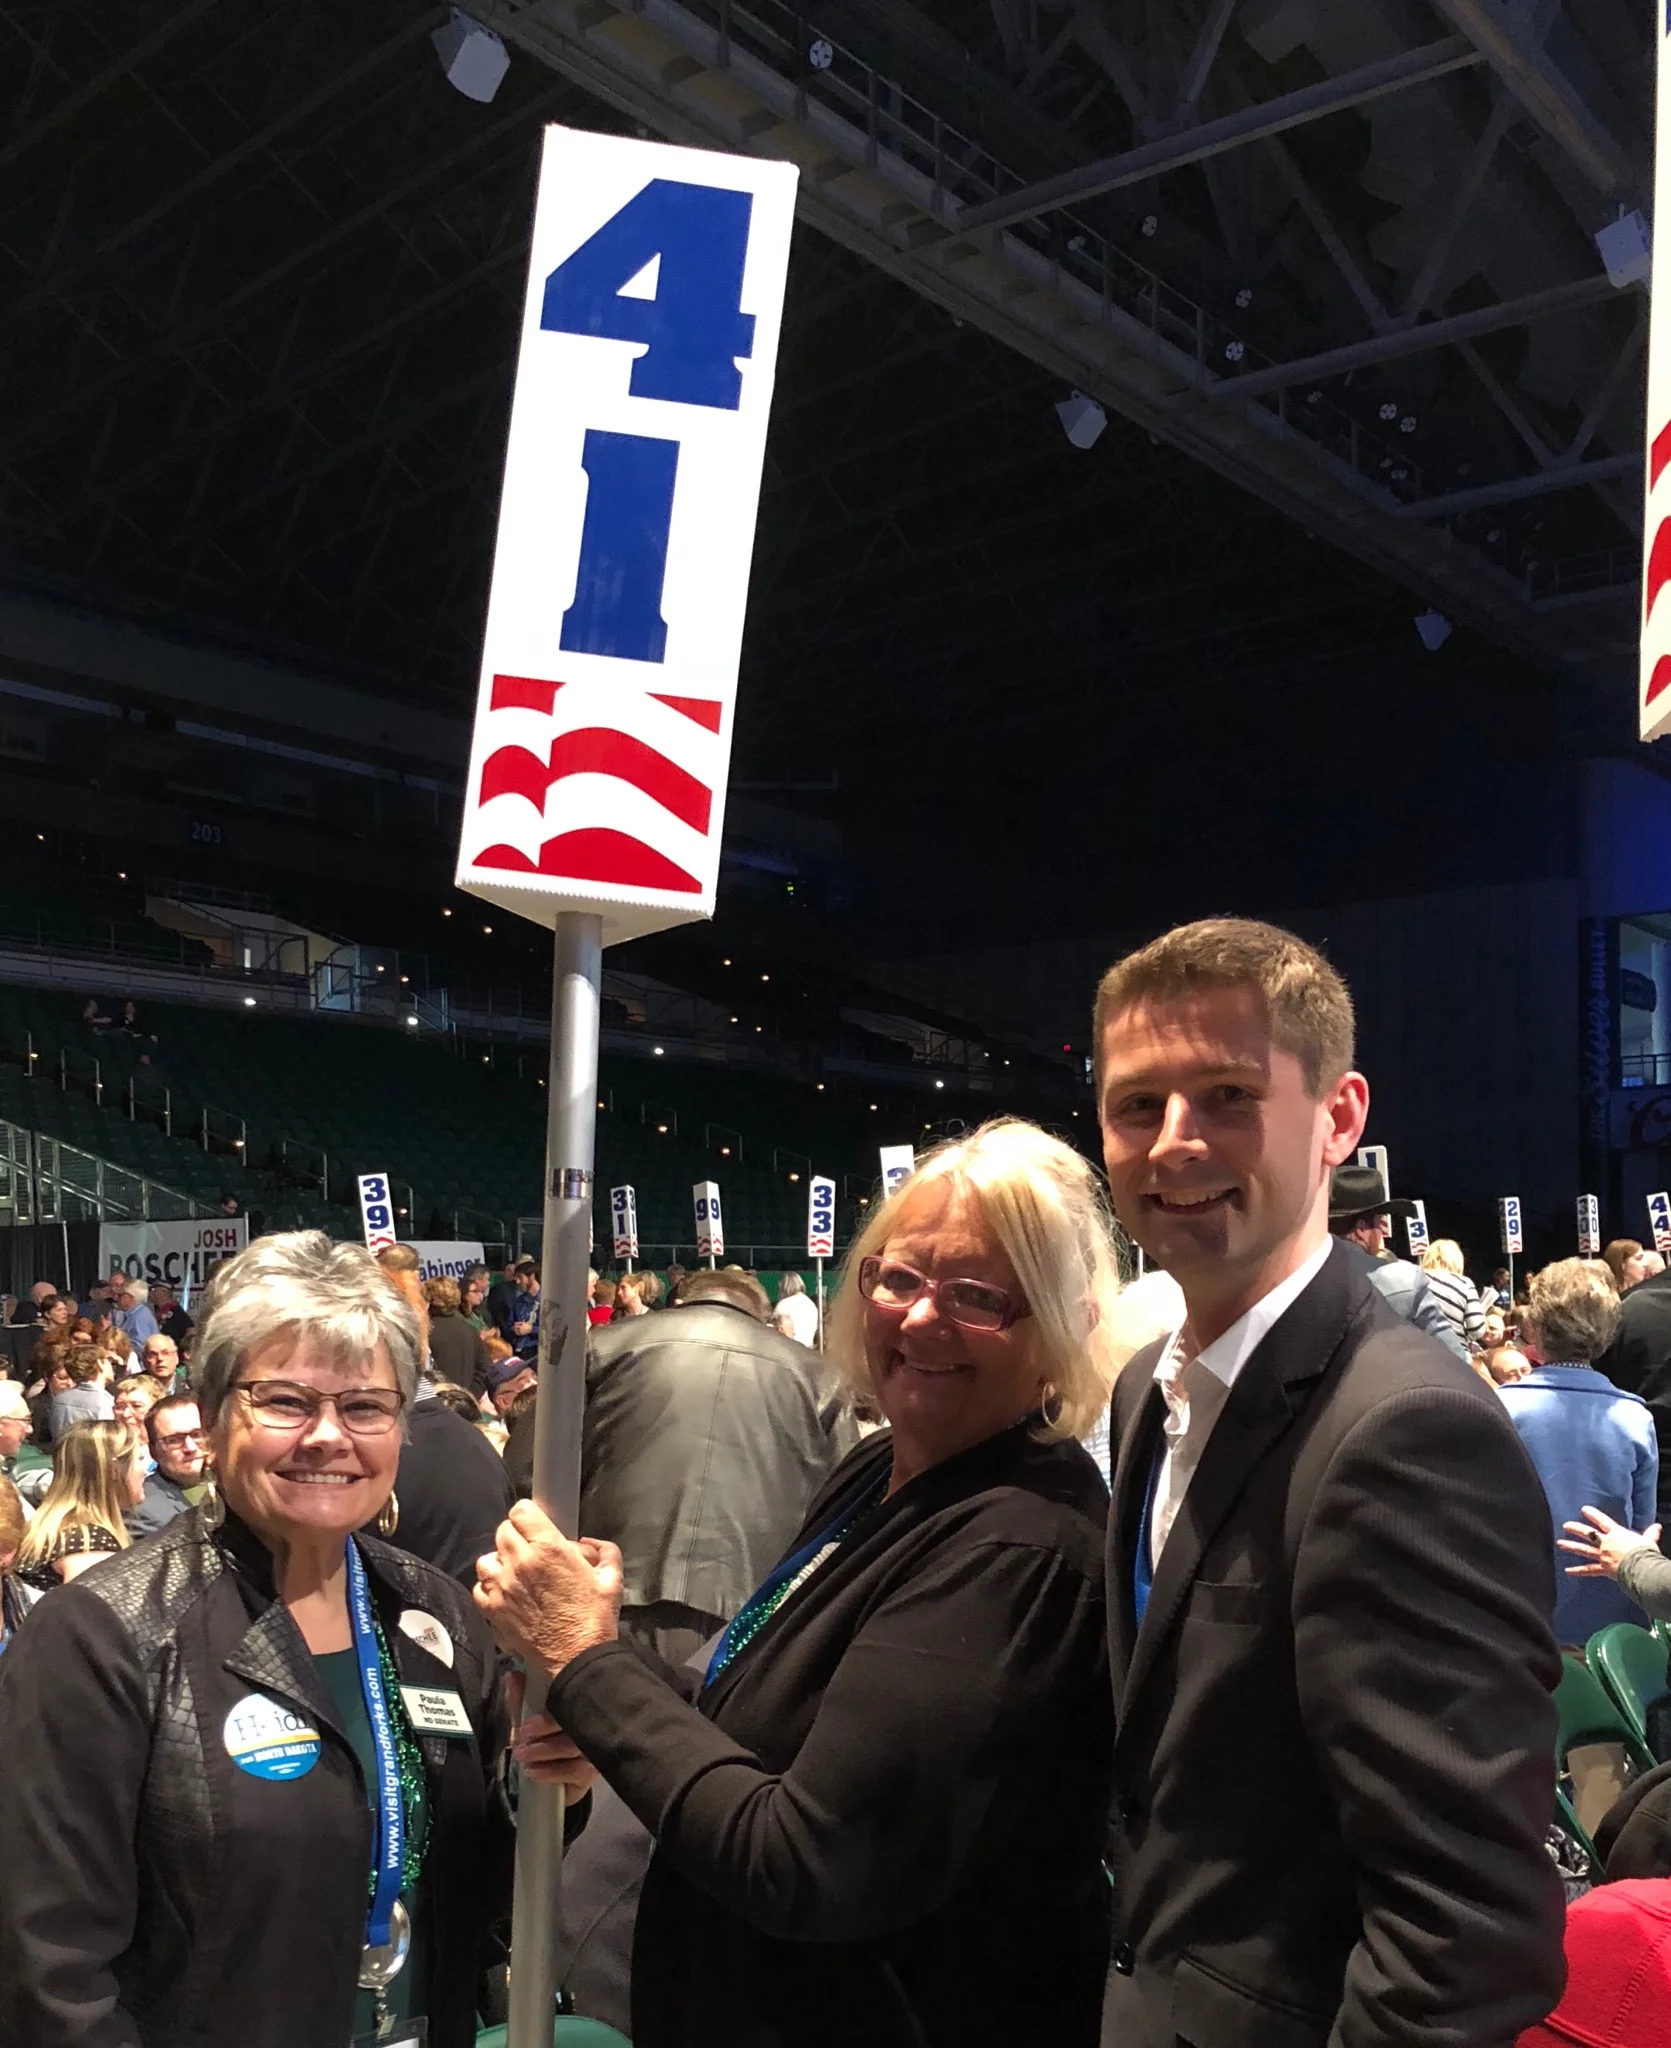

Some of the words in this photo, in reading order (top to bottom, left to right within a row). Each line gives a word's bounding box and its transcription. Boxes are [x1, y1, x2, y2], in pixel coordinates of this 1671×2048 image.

[191, 822, 221, 843] 203
[362, 1177, 390, 1230] 39
[612, 1189, 628, 1235] 31
[696, 1198, 708, 1221] 9
[710, 1197, 720, 1220] 9
[812, 1184, 833, 1234] 33
[1507, 1200, 1520, 1236] 29
[193, 1228, 238, 1249] JOSH
[419, 1256, 481, 1282] abinge
[418, 1703, 456, 1717] Thomas
[419, 1693, 447, 1706] Paula
[366, 1667, 399, 1870] www.visitgrandforks.com
